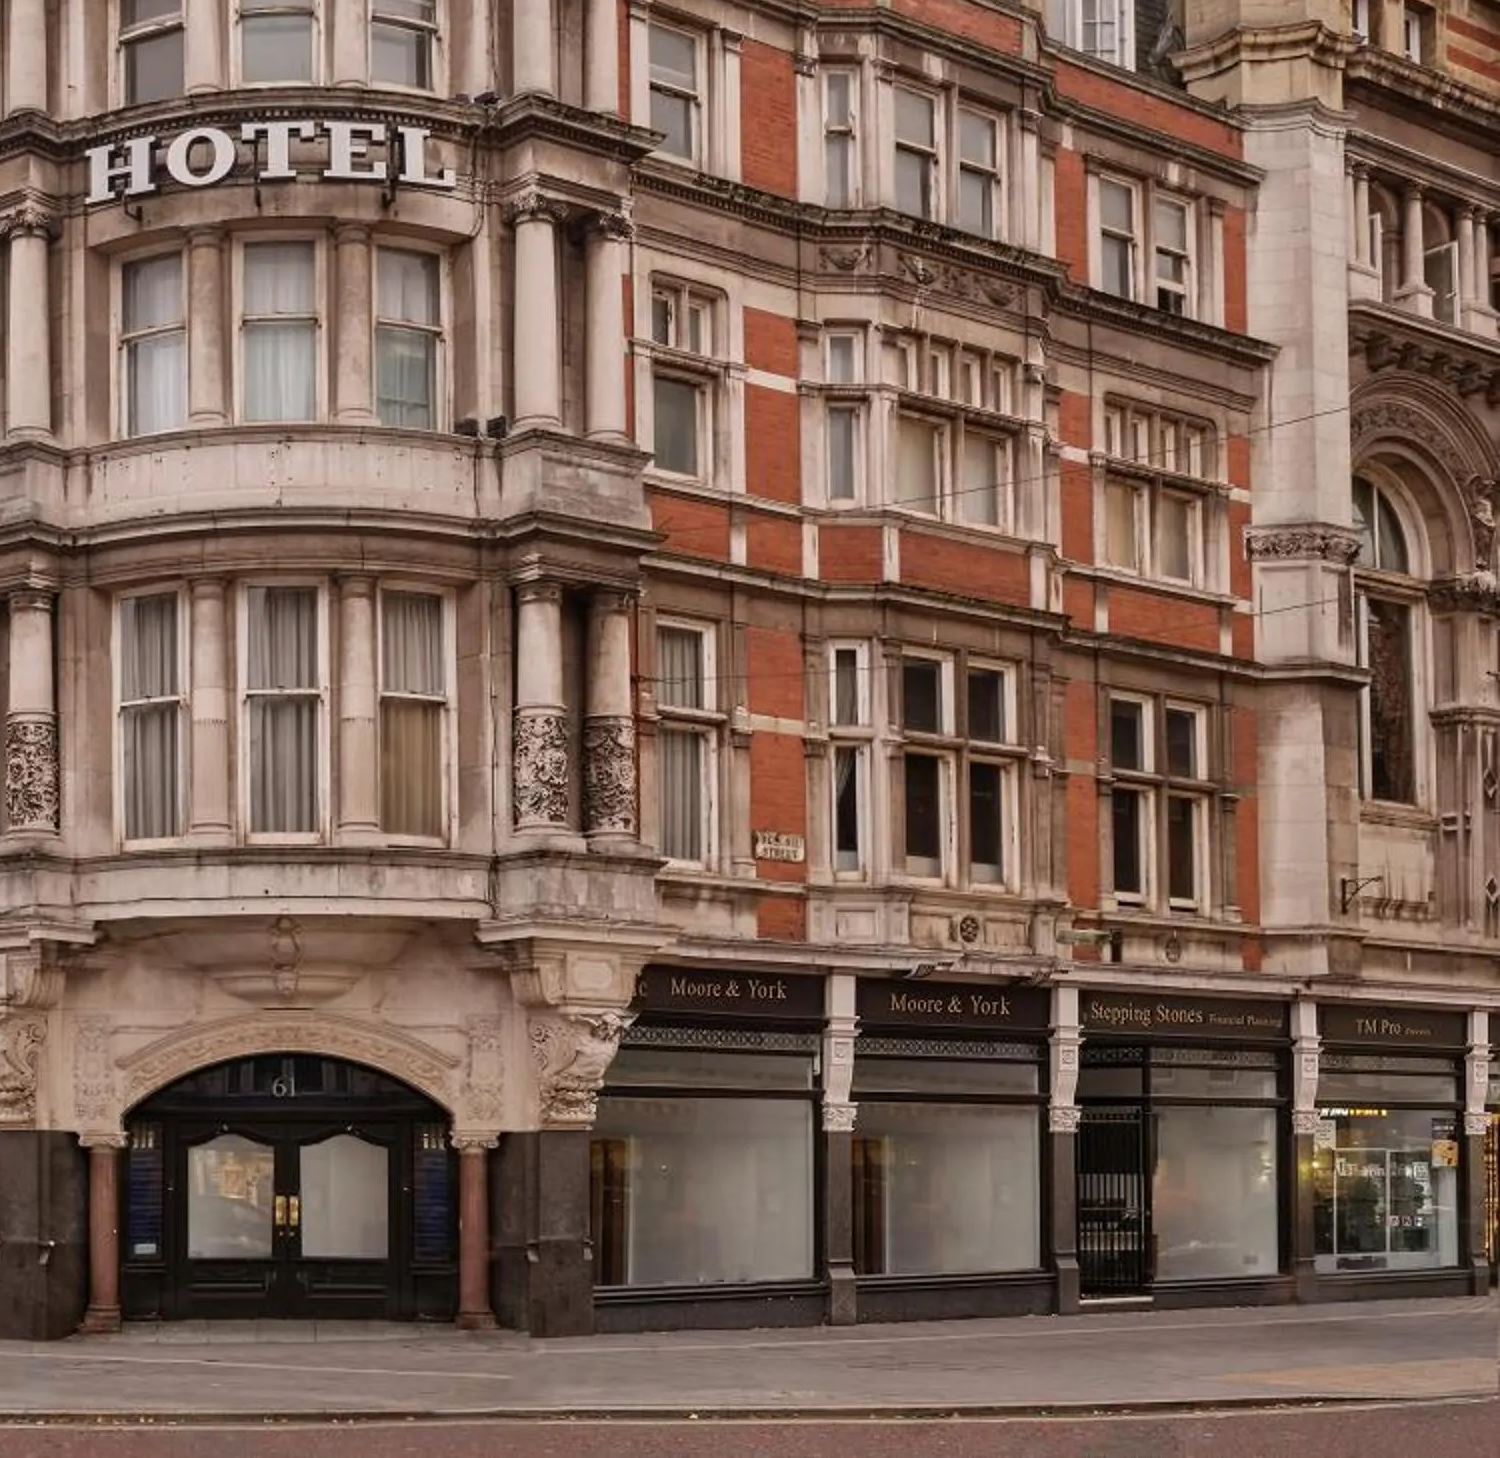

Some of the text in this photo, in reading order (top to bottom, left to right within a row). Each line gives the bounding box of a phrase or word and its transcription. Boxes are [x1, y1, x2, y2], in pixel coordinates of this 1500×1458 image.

[85, 121, 457, 204] HOTEL
[671, 977, 787, 999] Moore & York
[890, 993, 1011, 1015] Moore & York
[1091, 1002, 1151, 1025] Stepping
[1156, 1005, 1203, 1023] Stones
[1357, 1019, 1377, 1035] TM
[1380, 1019, 1402, 1035] Pro
[272, 1076, 295, 1097] 61
